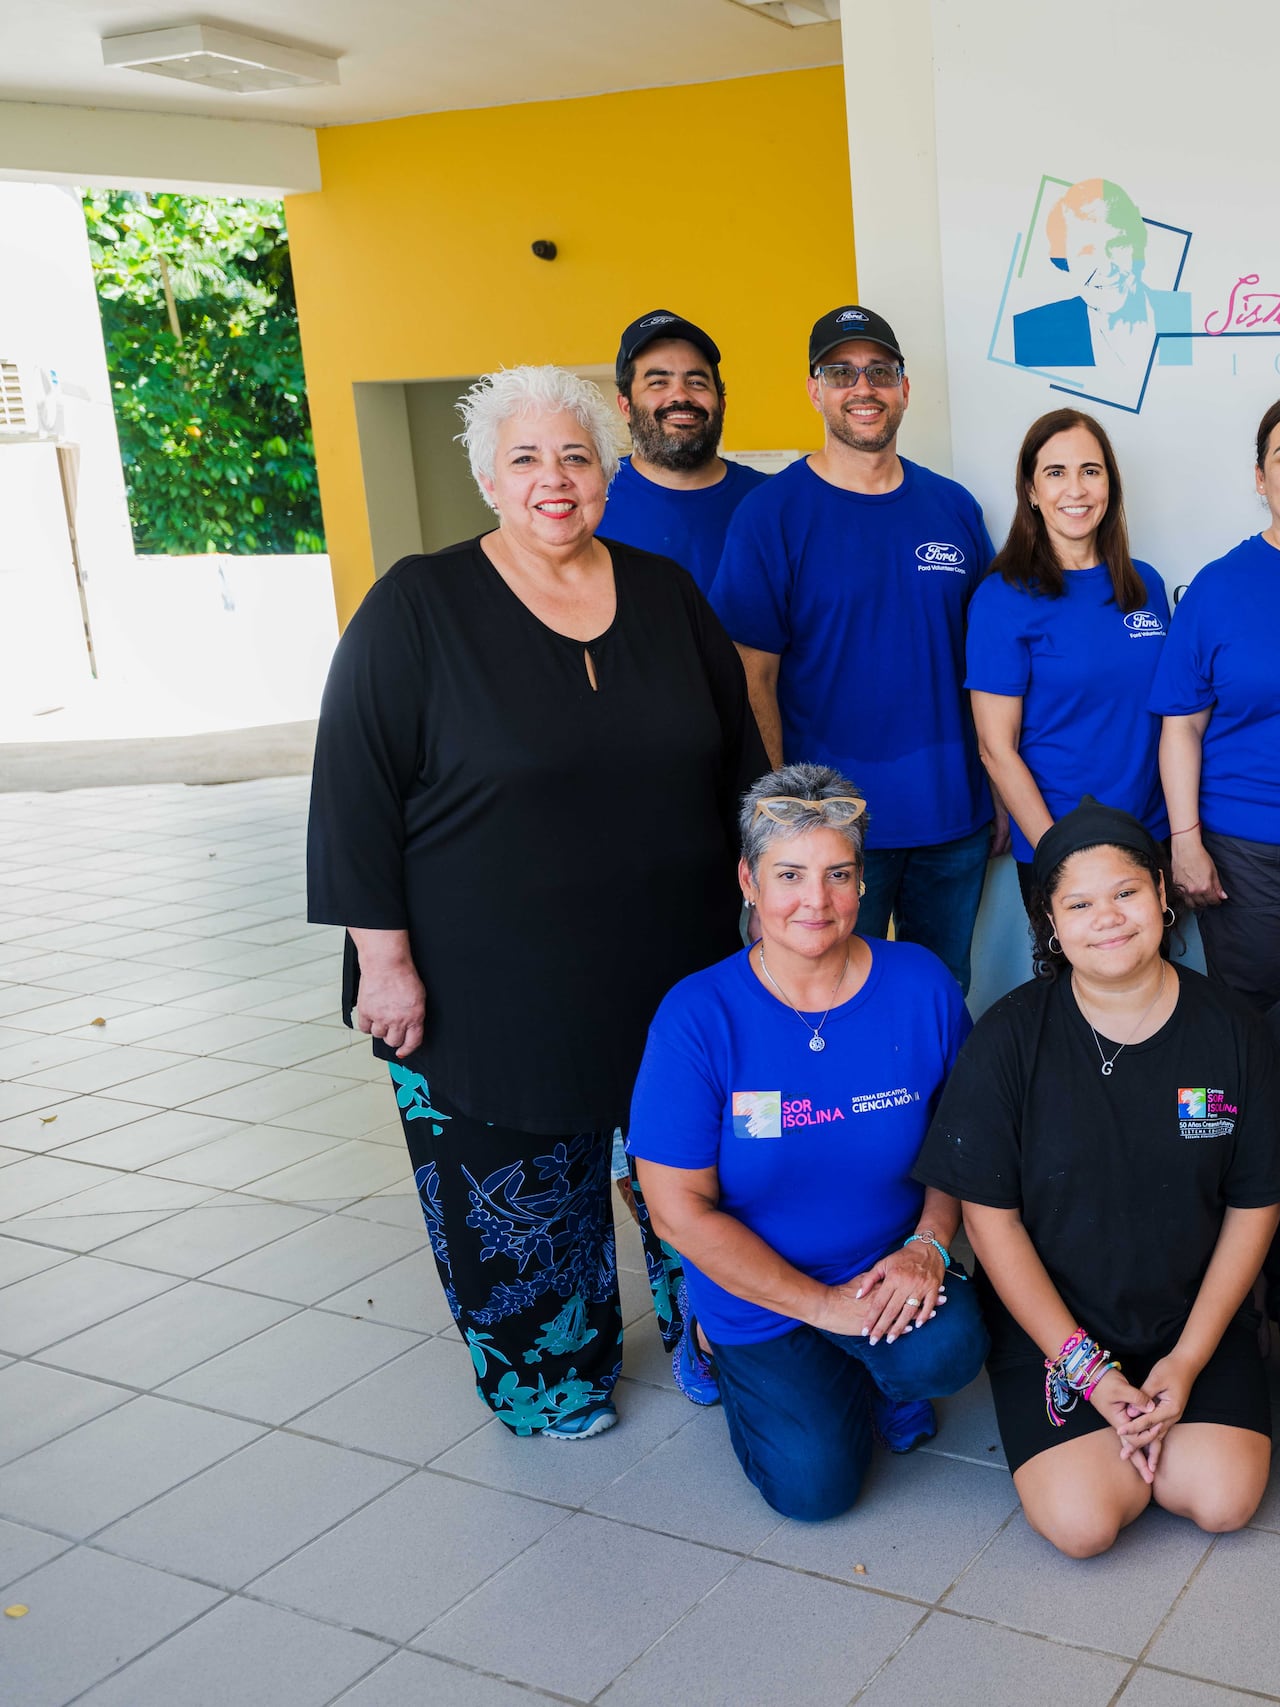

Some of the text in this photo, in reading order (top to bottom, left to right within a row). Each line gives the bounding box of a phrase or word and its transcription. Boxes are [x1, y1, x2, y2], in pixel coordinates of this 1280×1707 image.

[925, 545, 957, 562] Ford
[1133, 613, 1159, 627] Ford
[852, 1088, 908, 1103] SISTEMA EDUCATIVO
[782, 1099, 812, 1115] SOR
[852, 1099, 893, 1113] CIENCIA
[1207, 1104, 1238, 1114] ISOLINA
[783, 1107, 845, 1128] ISOLINA
